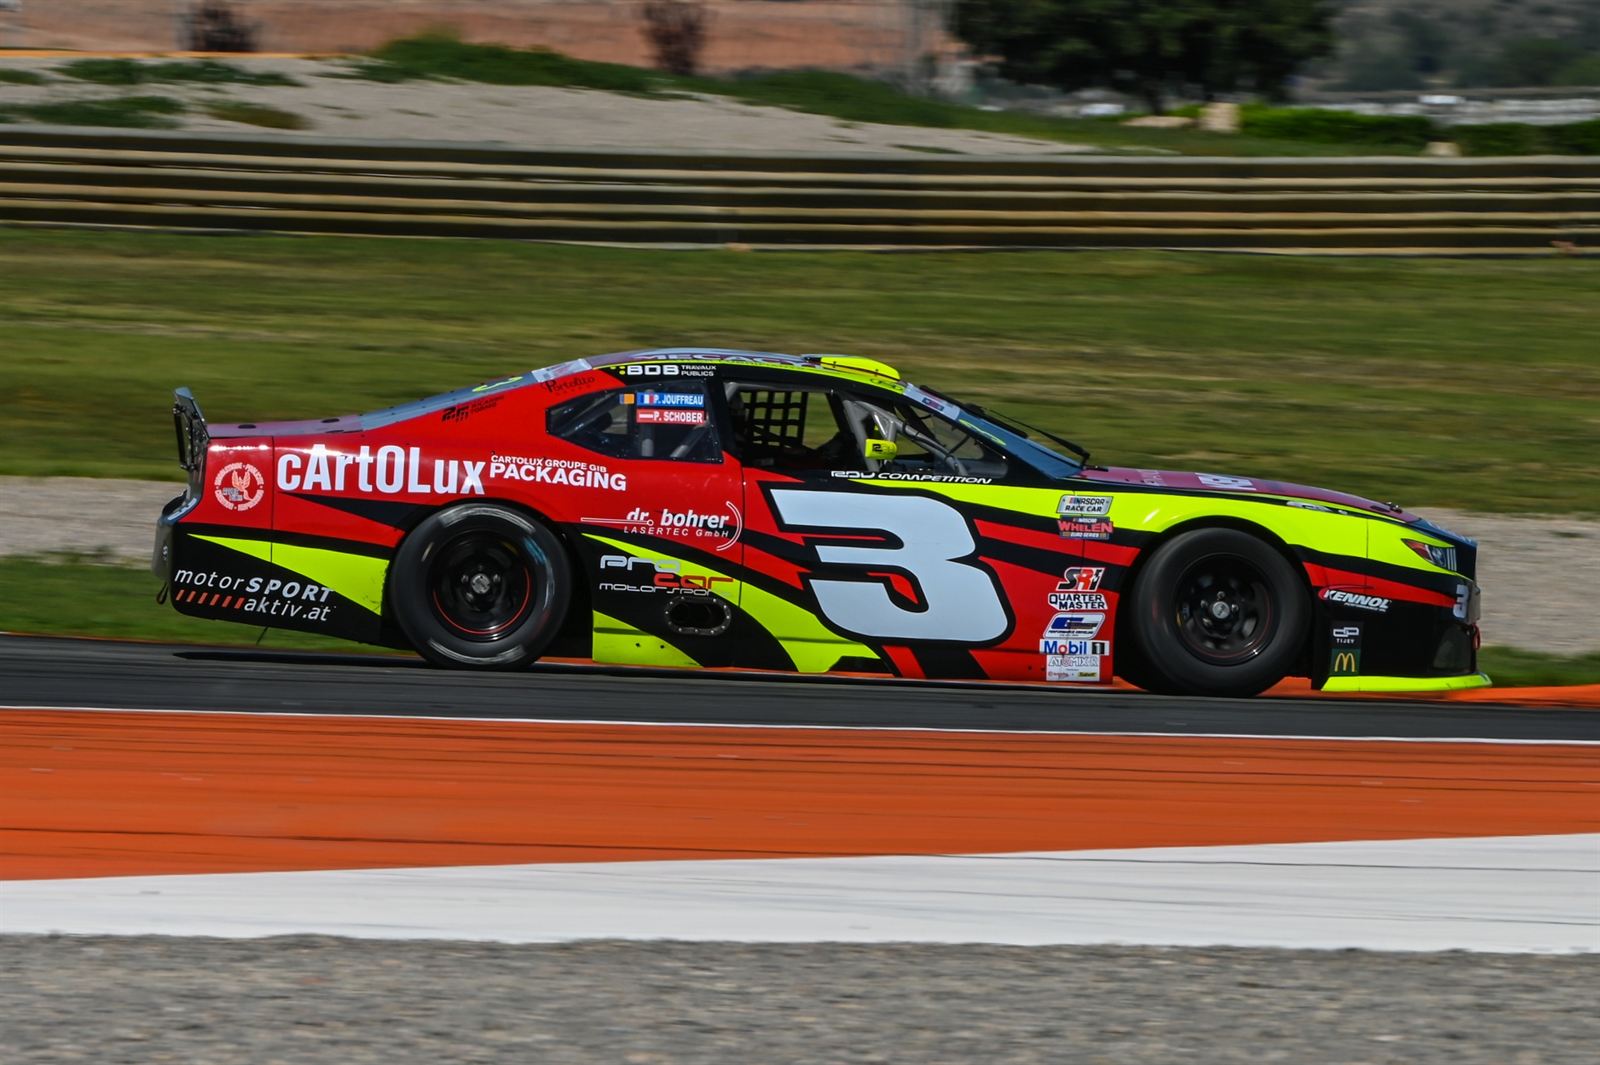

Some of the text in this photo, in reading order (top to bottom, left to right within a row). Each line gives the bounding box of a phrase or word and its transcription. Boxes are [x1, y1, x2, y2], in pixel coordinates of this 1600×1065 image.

[627, 364, 678, 376] BDB
[661, 394, 704, 406] JOUFFREAU
[653, 410, 704, 424] P. SCHOBER
[491, 454, 544, 467] CARTOLUX
[545, 459, 588, 471] GROUPE
[490, 462, 627, 491] PACKAGING
[878, 472, 992, 485] COMPETITION
[1065, 504, 1103, 513] RACE CAR
[661, 508, 730, 529] bohrer
[623, 526, 730, 538] LASERTEC GmbH
[1057, 520, 1114, 534] WHELEN
[769, 488, 1009, 642] 3
[1049, 593, 1103, 605] QUARTER
[1058, 601, 1105, 611] MASTER
[1324, 589, 1389, 610] KENNOL
[244, 597, 332, 622] aktiv.at
[1044, 641, 1087, 656] Mobil
